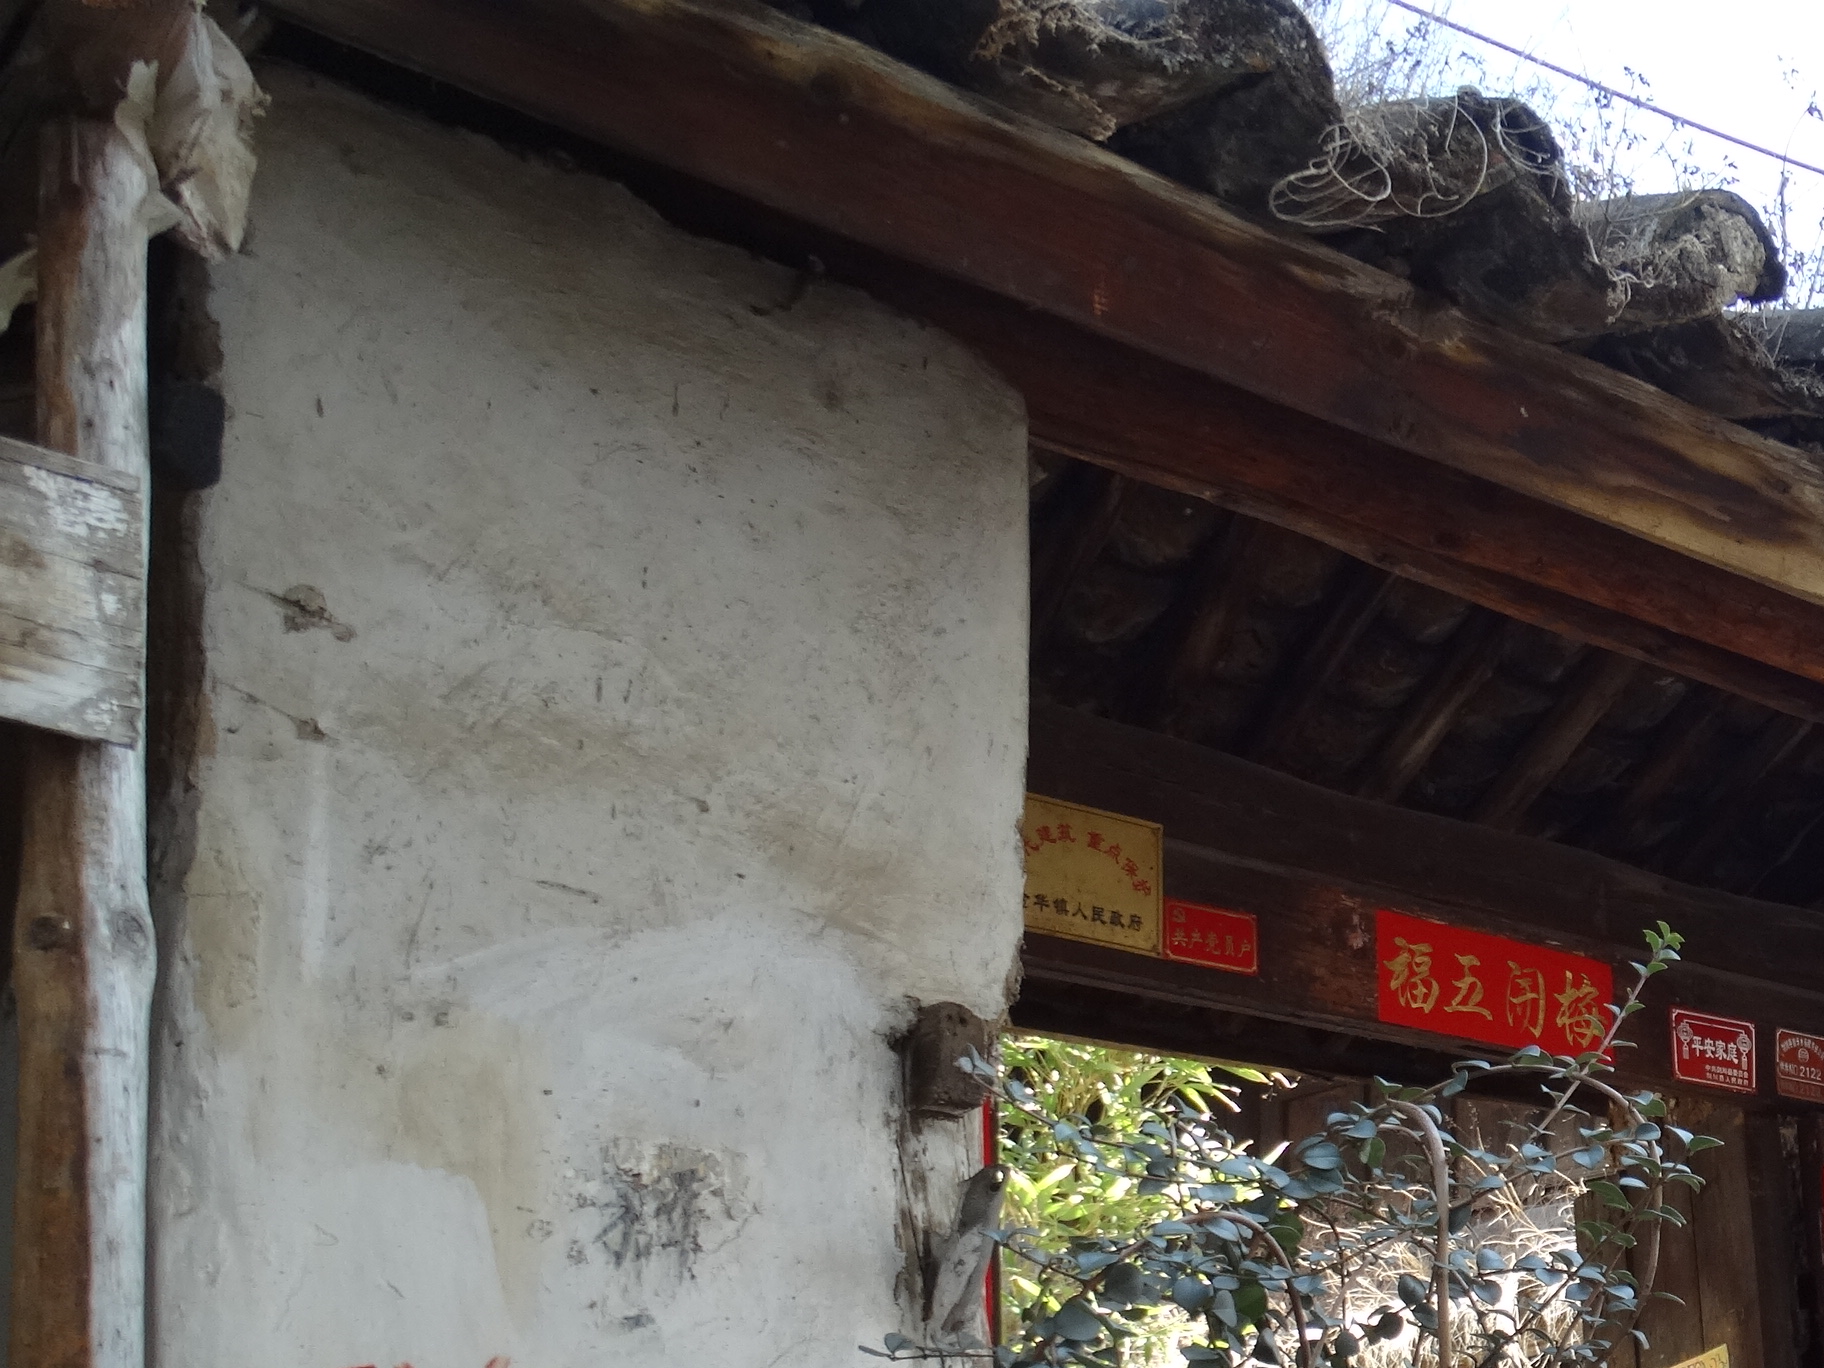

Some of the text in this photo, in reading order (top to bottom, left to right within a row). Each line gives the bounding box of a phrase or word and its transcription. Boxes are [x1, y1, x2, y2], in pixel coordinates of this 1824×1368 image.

[1691, 1035, 1739, 1065] 平安家庭
[1799, 1065, 1823, 1081] 2122
